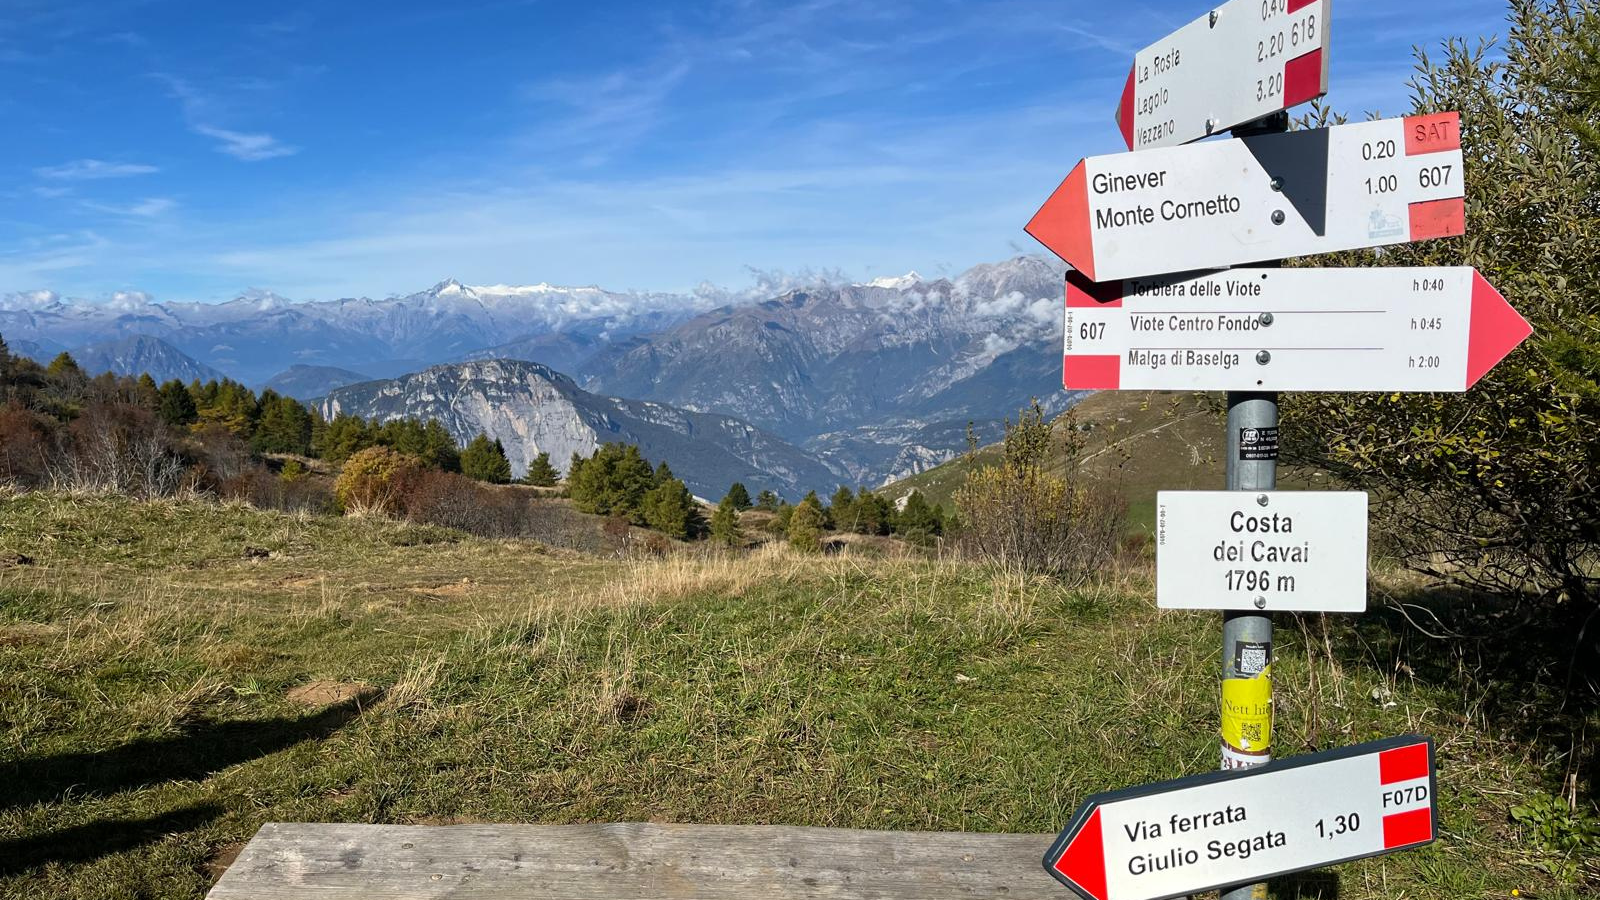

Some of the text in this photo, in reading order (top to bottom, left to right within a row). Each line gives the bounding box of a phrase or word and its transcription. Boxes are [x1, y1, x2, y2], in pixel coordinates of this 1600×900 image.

[1292, 14, 1315, 47] 618
[1257, 31, 1284, 63] 2.20
[1138, 48, 1181, 84] La Rosta
[1257, 72, 1282, 102] 3.20
[1137, 87, 1169, 116] Lagolo
[1137, 118, 1175, 146] Vezzano
[1415, 121, 1450, 141] SAT
[1362, 140, 1395, 161] 0.20
[1092, 170, 1167, 194] Ginever
[1365, 174, 1397, 195] 1.00
[1419, 165, 1452, 188] 607
[1095, 193, 1241, 230] Monte Cornetto
[1131, 281, 1261, 296] Torbiera delle Viote
[1413, 279, 1444, 291] h 0:40
[1080, 322, 1106, 340] 607
[1130, 315, 1259, 331] Viote Centro Fondo
[1411, 318, 1442, 330] h 0:45
[1128, 350, 1239, 369] Malga di Baselga
[1409, 356, 1440, 368] h 2:00
[1230, 511, 1293, 533] Costa
[1213, 540, 1309, 563] dei Cavai
[1225, 570, 1295, 592] 1796 m
[1224, 698, 1249, 715] Nett
[1382, 785, 1428, 808] F07D
[1124, 804, 1247, 843] Via ferrata
[1315, 812, 1360, 843] 1,30
[1128, 829, 1287, 876] Giulio Segata
